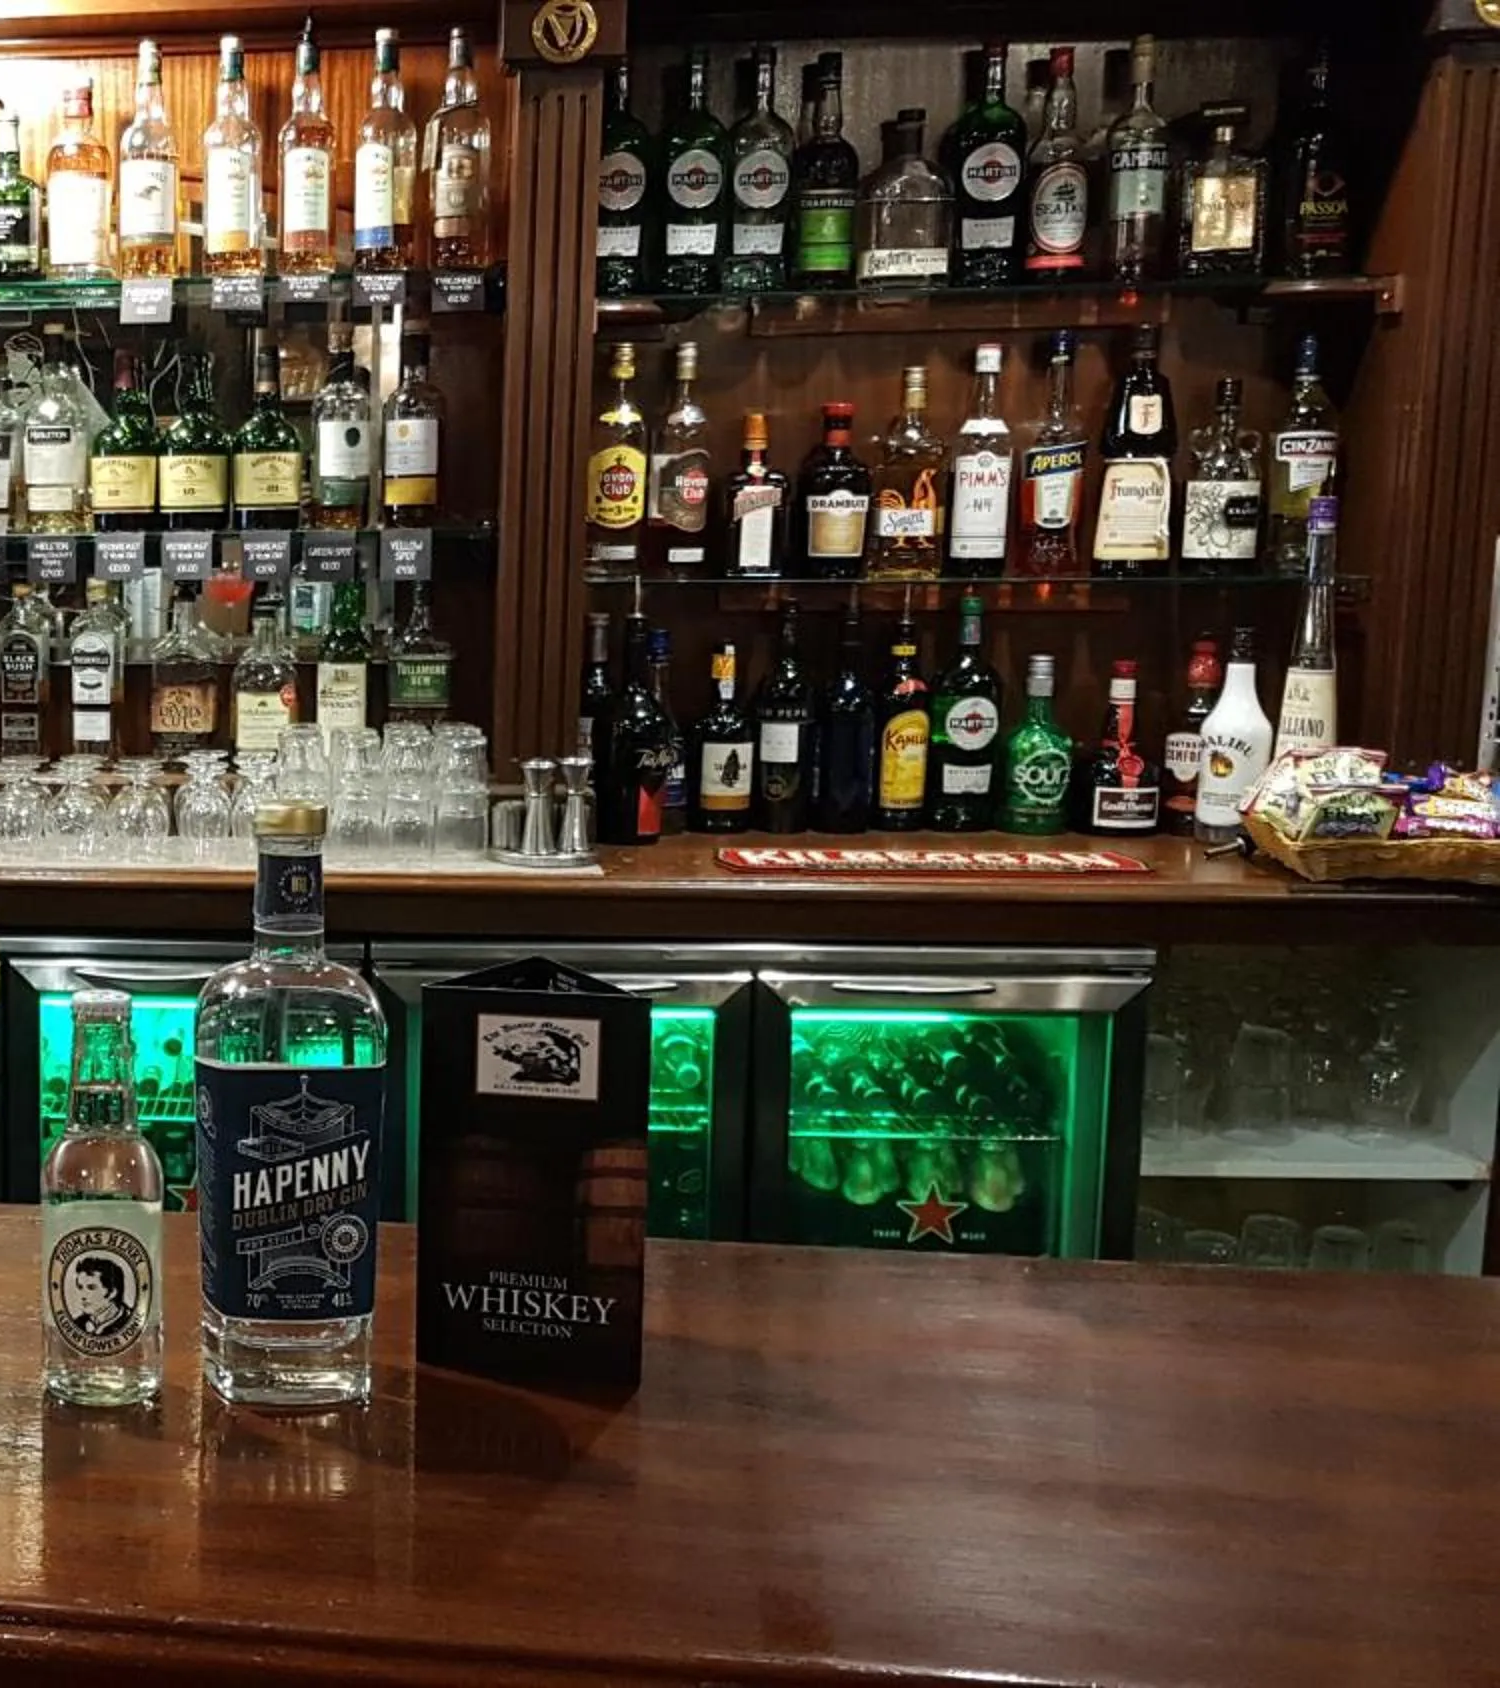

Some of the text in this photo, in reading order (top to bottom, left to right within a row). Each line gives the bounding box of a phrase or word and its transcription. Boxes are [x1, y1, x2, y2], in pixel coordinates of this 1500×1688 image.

[1112, 151, 1169, 170] CAMPA
[967, 165, 1017, 177] MARTINI
[1280, 438, 1336, 455] CINZAN
[1031, 450, 1084, 471] APEROL
[603, 483, 632, 496] Club
[675, 474, 708, 488] Havan
[2, 654, 36, 664] BLACK
[1165, 750, 1201, 762] COMFO
[233, 1139, 371, 1211] HA'PENNY
[232, 1182, 368, 1232] DUBLIN DRY GIN
[56, 1233, 145, 1265] THOMAS HENRY
[488, 1270, 568, 1291] PREMIUM
[442, 1283, 618, 1326] WHISKEY
[482, 1317, 573, 1339] SELECTION
